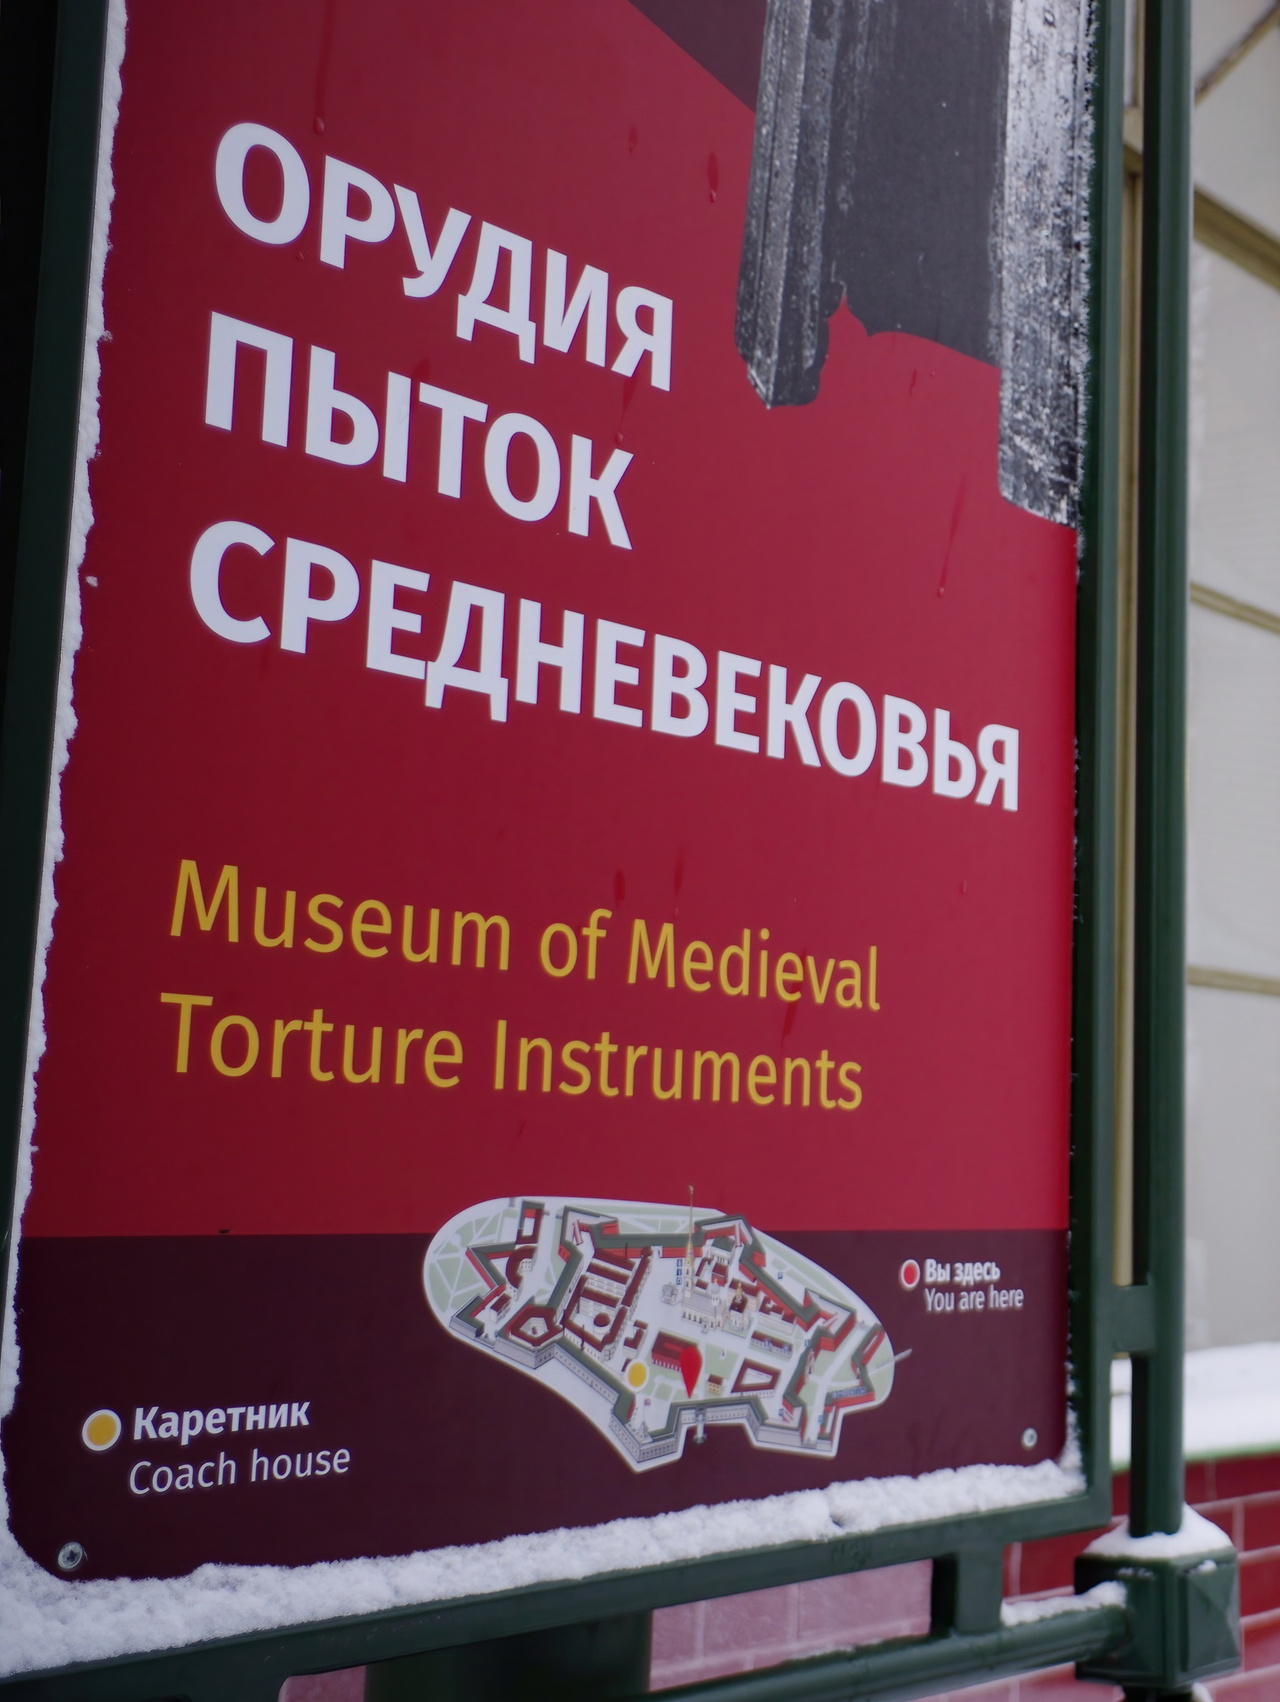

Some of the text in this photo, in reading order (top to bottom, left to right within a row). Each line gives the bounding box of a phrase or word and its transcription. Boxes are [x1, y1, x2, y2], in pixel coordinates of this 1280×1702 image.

[215, 123, 673, 391] ОРУДИЯ
[205, 311, 633, 550] ПЫТОК
[190, 521, 1019, 812] СРЕДНЕВЕКОВЬЯ
[171, 860, 880, 1011] Museum of Medieval
[161, 993, 862, 1110] Torture Instruments
[924, 1259, 1001, 1286] Вы здесь
[924, 1285, 1024, 1311] You are here
[130, 1449, 350, 1494] Coach house
[134, 1402, 310, 1445] Каретник
